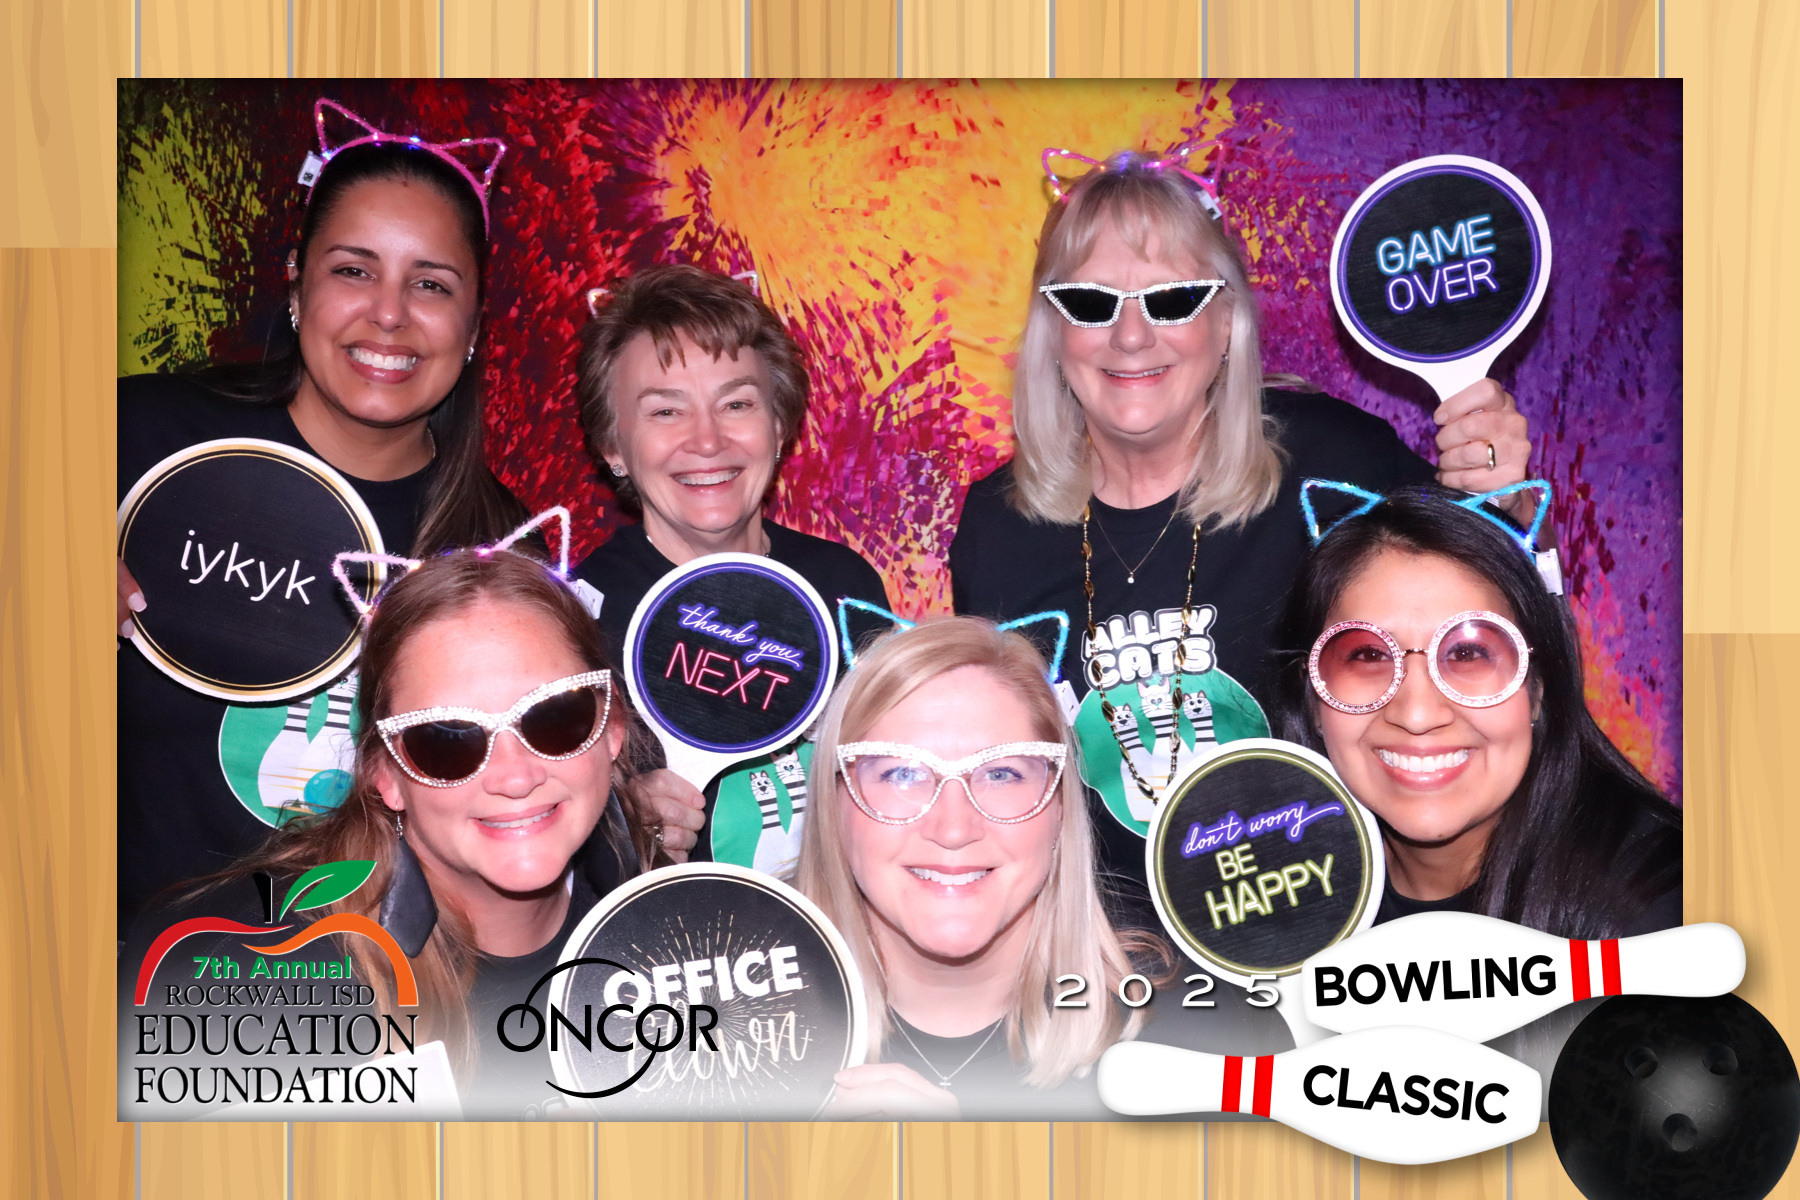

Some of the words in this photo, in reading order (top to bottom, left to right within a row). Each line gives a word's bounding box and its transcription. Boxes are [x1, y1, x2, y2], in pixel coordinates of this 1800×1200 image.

[1378, 215, 1494, 274] GAME
[1388, 257, 1497, 312] OVER
[180, 529, 316, 605] iykyk
[681, 606, 754, 643] thank
[745, 638, 801, 668] you
[1083, 606, 1214, 659] ALLEY
[665, 642, 790, 710] NEXT
[1086, 636, 1213, 690] CATS
[1185, 816, 1242, 854] don't
[1250, 805, 1341, 838] worry
[1205, 853, 1334, 930] HAPPY
[1215, 843, 1258, 881] BE
[603, 945, 804, 1018] OFFICE
